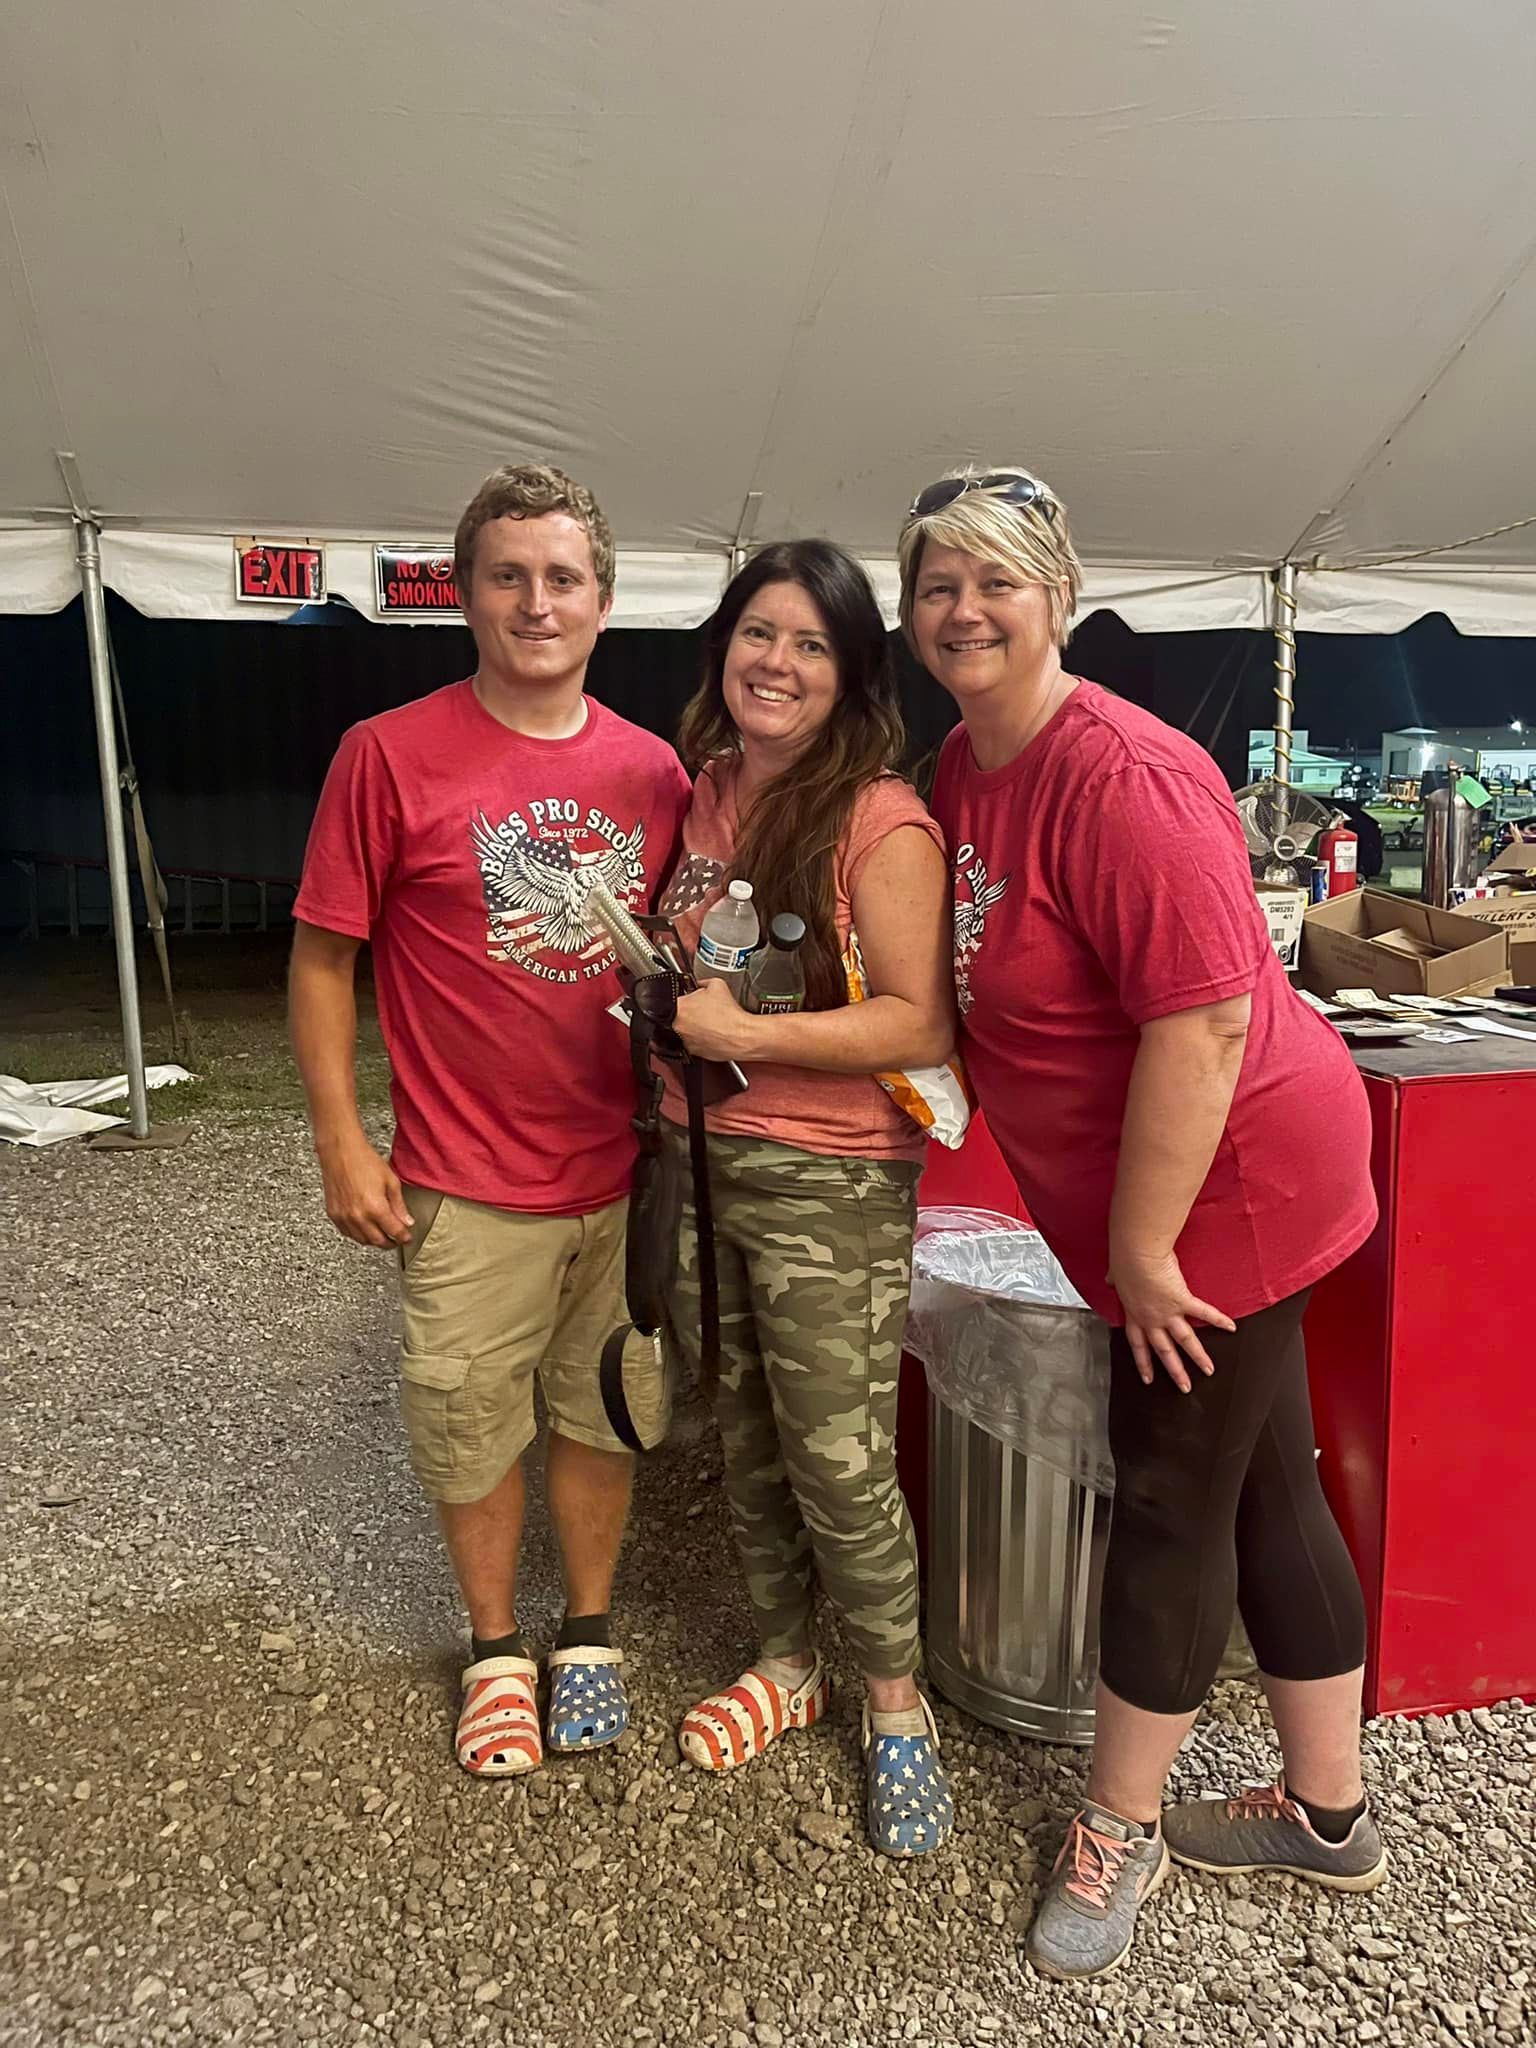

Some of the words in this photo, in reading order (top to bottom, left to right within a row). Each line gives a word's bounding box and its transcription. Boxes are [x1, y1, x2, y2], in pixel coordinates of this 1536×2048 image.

[243, 549, 319, 596] EXIT
[396, 559, 420, 578] NO
[481, 812, 528, 878] BASS
[529, 799, 579, 825] PRO
[586, 808, 645, 878] SHOPS
[538, 826, 561, 838] Since
[562, 828, 589, 838] 1972
[488, 914, 507, 937] AN
[503, 941, 579, 983] AMERICAN
[583, 952, 616, 978] TRAD
